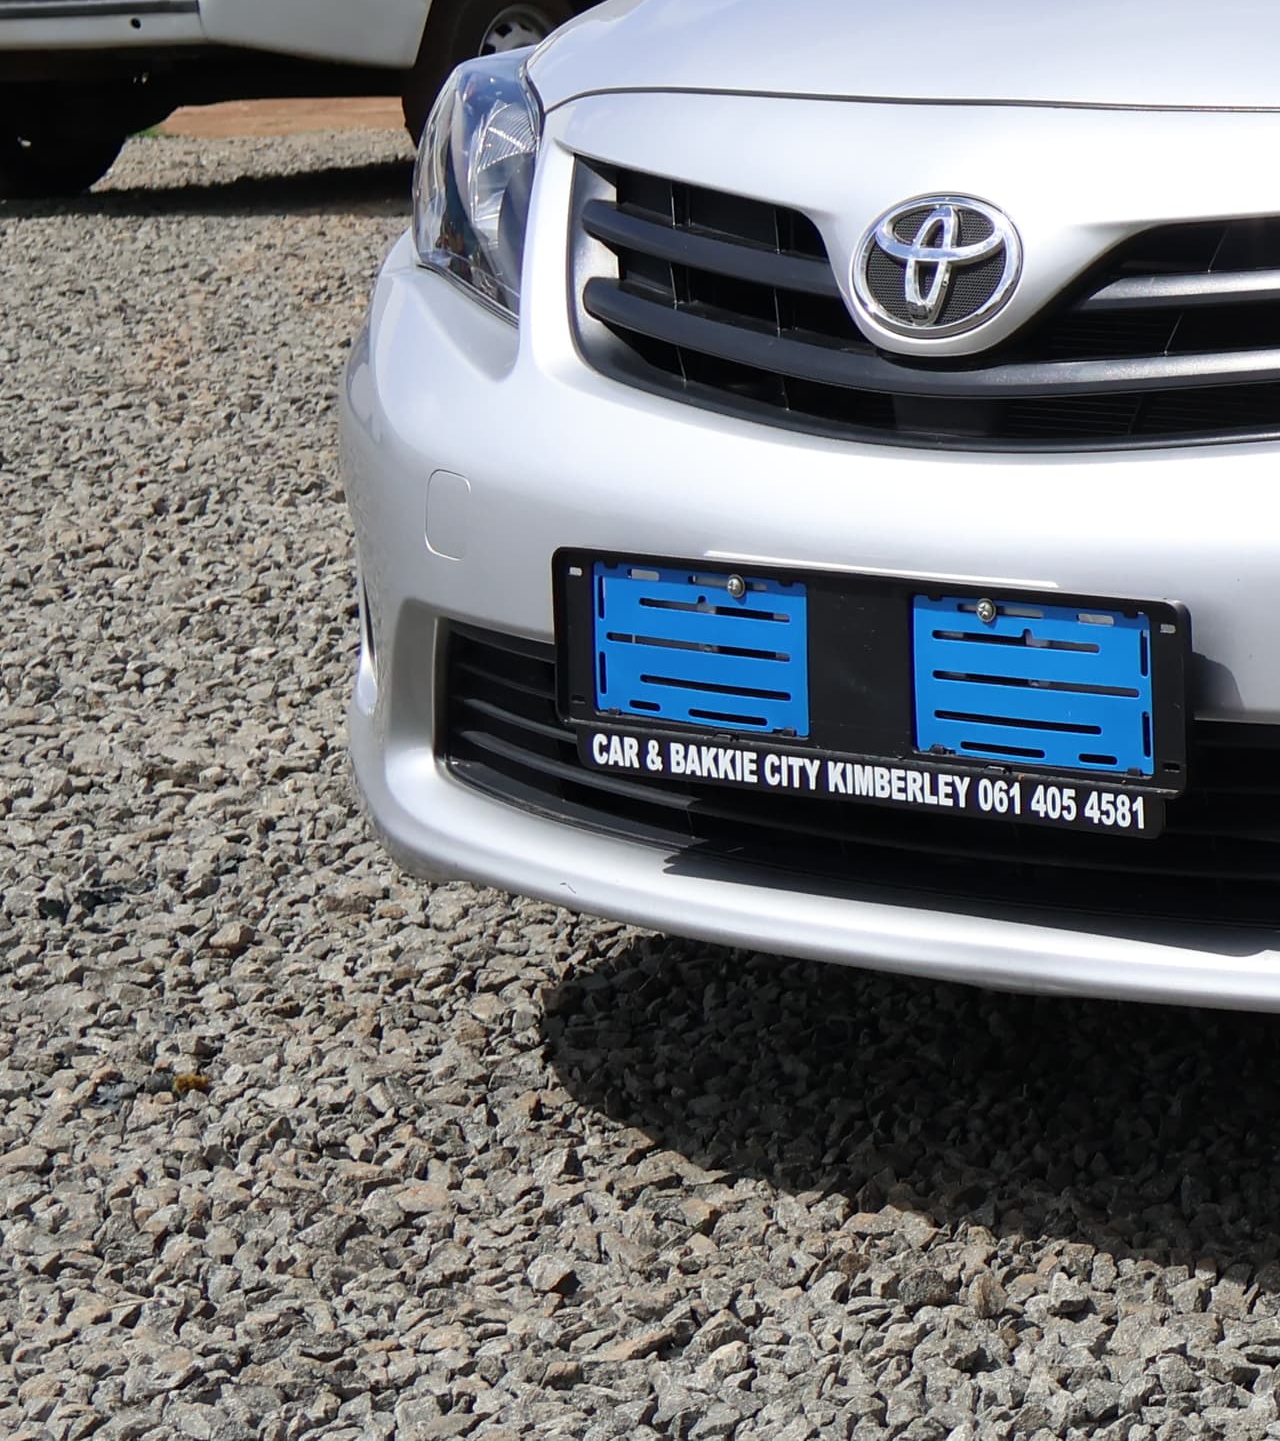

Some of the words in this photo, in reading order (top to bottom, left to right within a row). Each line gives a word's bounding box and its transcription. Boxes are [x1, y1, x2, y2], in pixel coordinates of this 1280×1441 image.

[592, 732, 639, 770] CAR
[646, 736, 664, 772] &
[669, 739, 758, 784] BAKKIE
[764, 753, 821, 791] CITY
[827, 760, 970, 809] KIMBERLEY
[978, 777, 1022, 815] 061
[1030, 785, 1077, 824] 405
[1083, 788, 1146, 830] 4581
